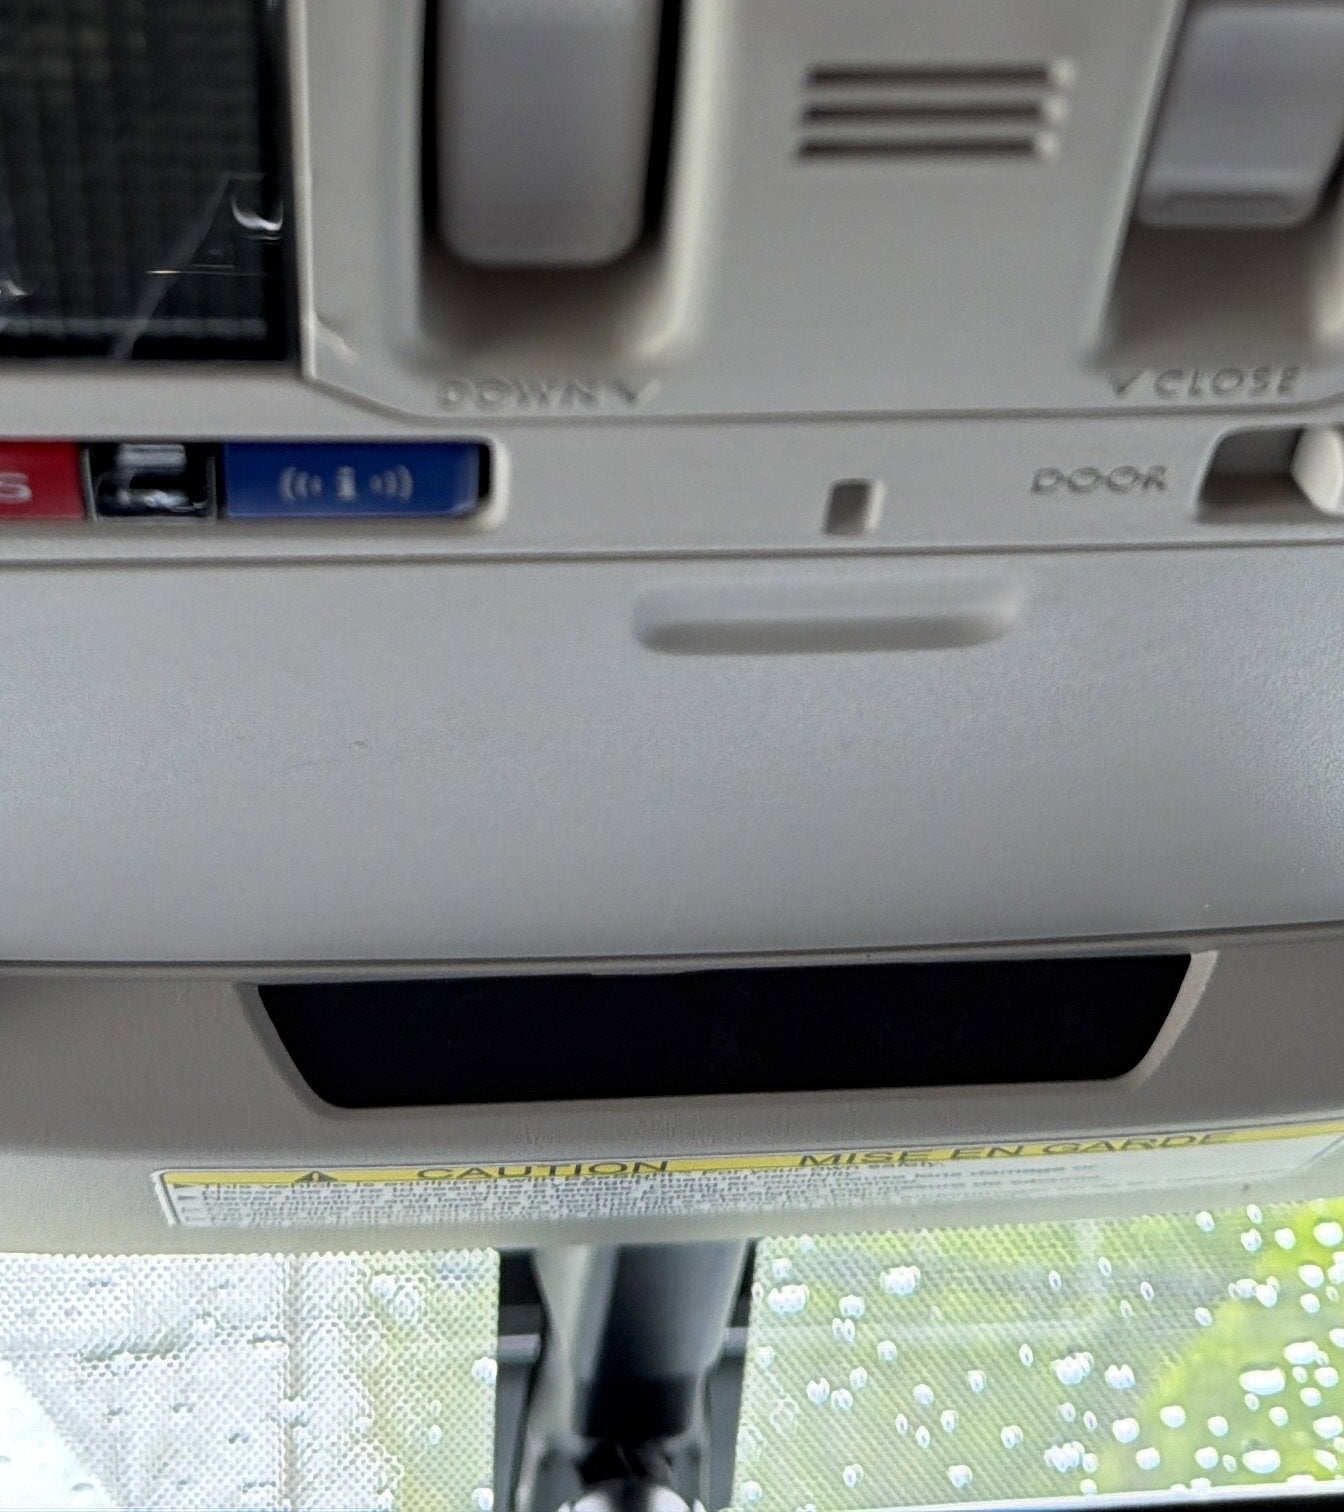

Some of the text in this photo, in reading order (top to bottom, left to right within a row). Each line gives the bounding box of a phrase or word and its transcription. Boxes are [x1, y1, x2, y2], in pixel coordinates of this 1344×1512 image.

[436, 378, 598, 411] DOWN
[1153, 367, 1300, 399] CLOSE
[1030, 465, 1166, 495] DOOR
[798, 1131, 1235, 1167] MISE EN GARDE
[416, 1159, 669, 1180] CAUTION
